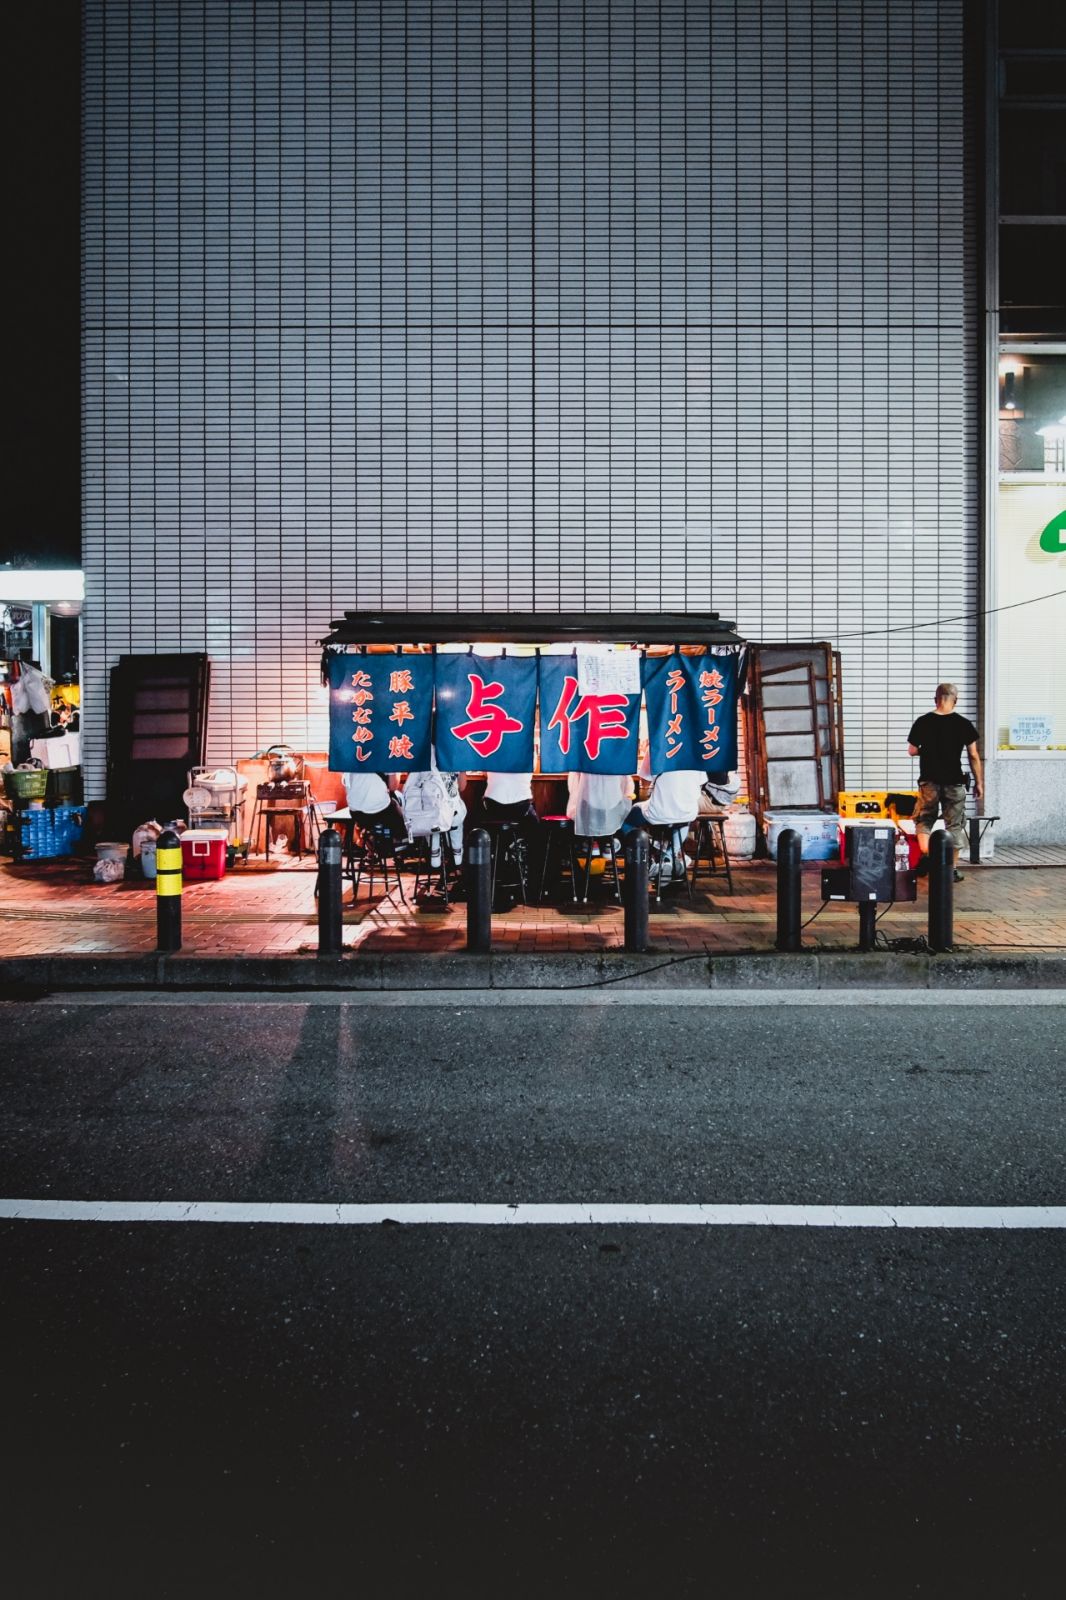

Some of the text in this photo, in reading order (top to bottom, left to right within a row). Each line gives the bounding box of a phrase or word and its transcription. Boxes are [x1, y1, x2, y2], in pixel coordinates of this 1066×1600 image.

[351, 670, 374, 762] たかなめし
[388, 669, 415, 759] 豚平焼
[664, 669, 686, 759] ラーメン
[698, 668, 725, 760] 焼ラーメン
